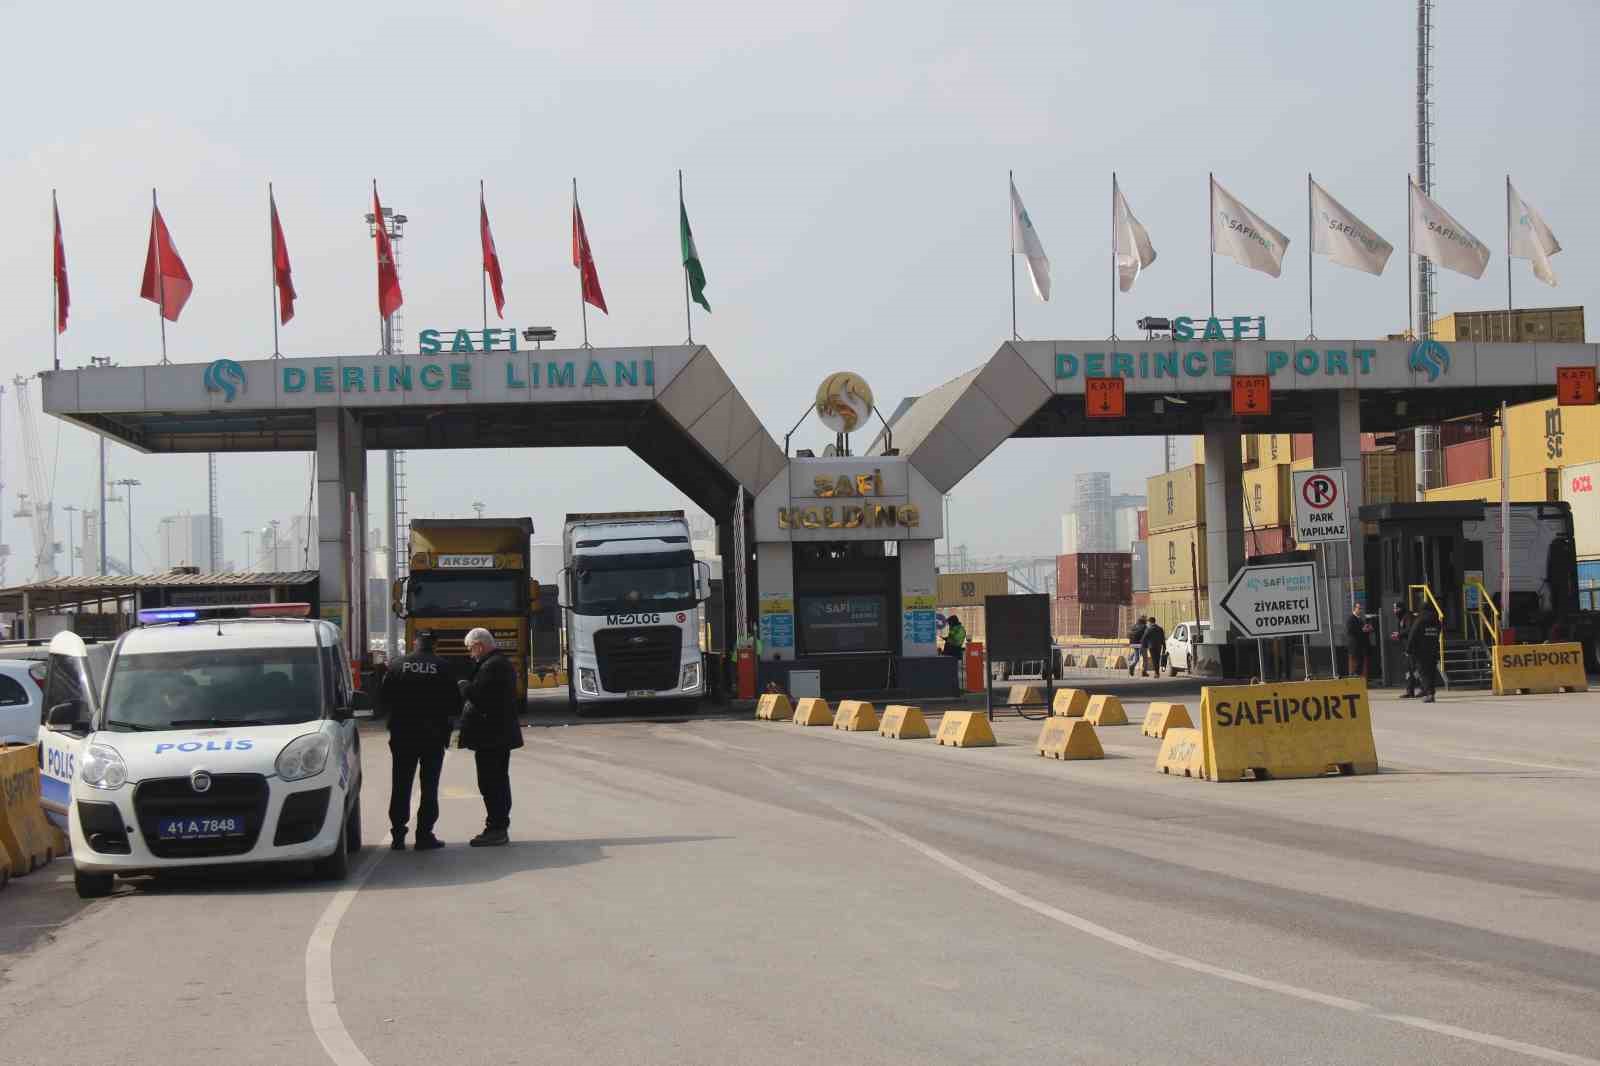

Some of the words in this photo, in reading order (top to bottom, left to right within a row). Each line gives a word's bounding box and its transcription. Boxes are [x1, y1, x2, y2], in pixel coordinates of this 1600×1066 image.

[1174, 316, 1265, 342] SAFİ
[419, 328, 517, 355] SAFİ
[1266, 349, 1376, 376] PORT
[813, 468, 883, 498] SAFİ
[1310, 512, 1334, 523] PARK
[1301, 525, 1345, 538] YAPILMAZ
[443, 556, 489, 566] AKSOY
[1254, 597, 1309, 613] ZİYARETÇİ
[1255, 614, 1310, 628] OTOPARKI
[1502, 649, 1580, 669] SAFİPORT
[1215, 692, 1361, 727] SAFİPORT
[167, 821, 184, 834] 41
[187, 820, 200, 833] A
[201, 818, 235, 833] 7848
